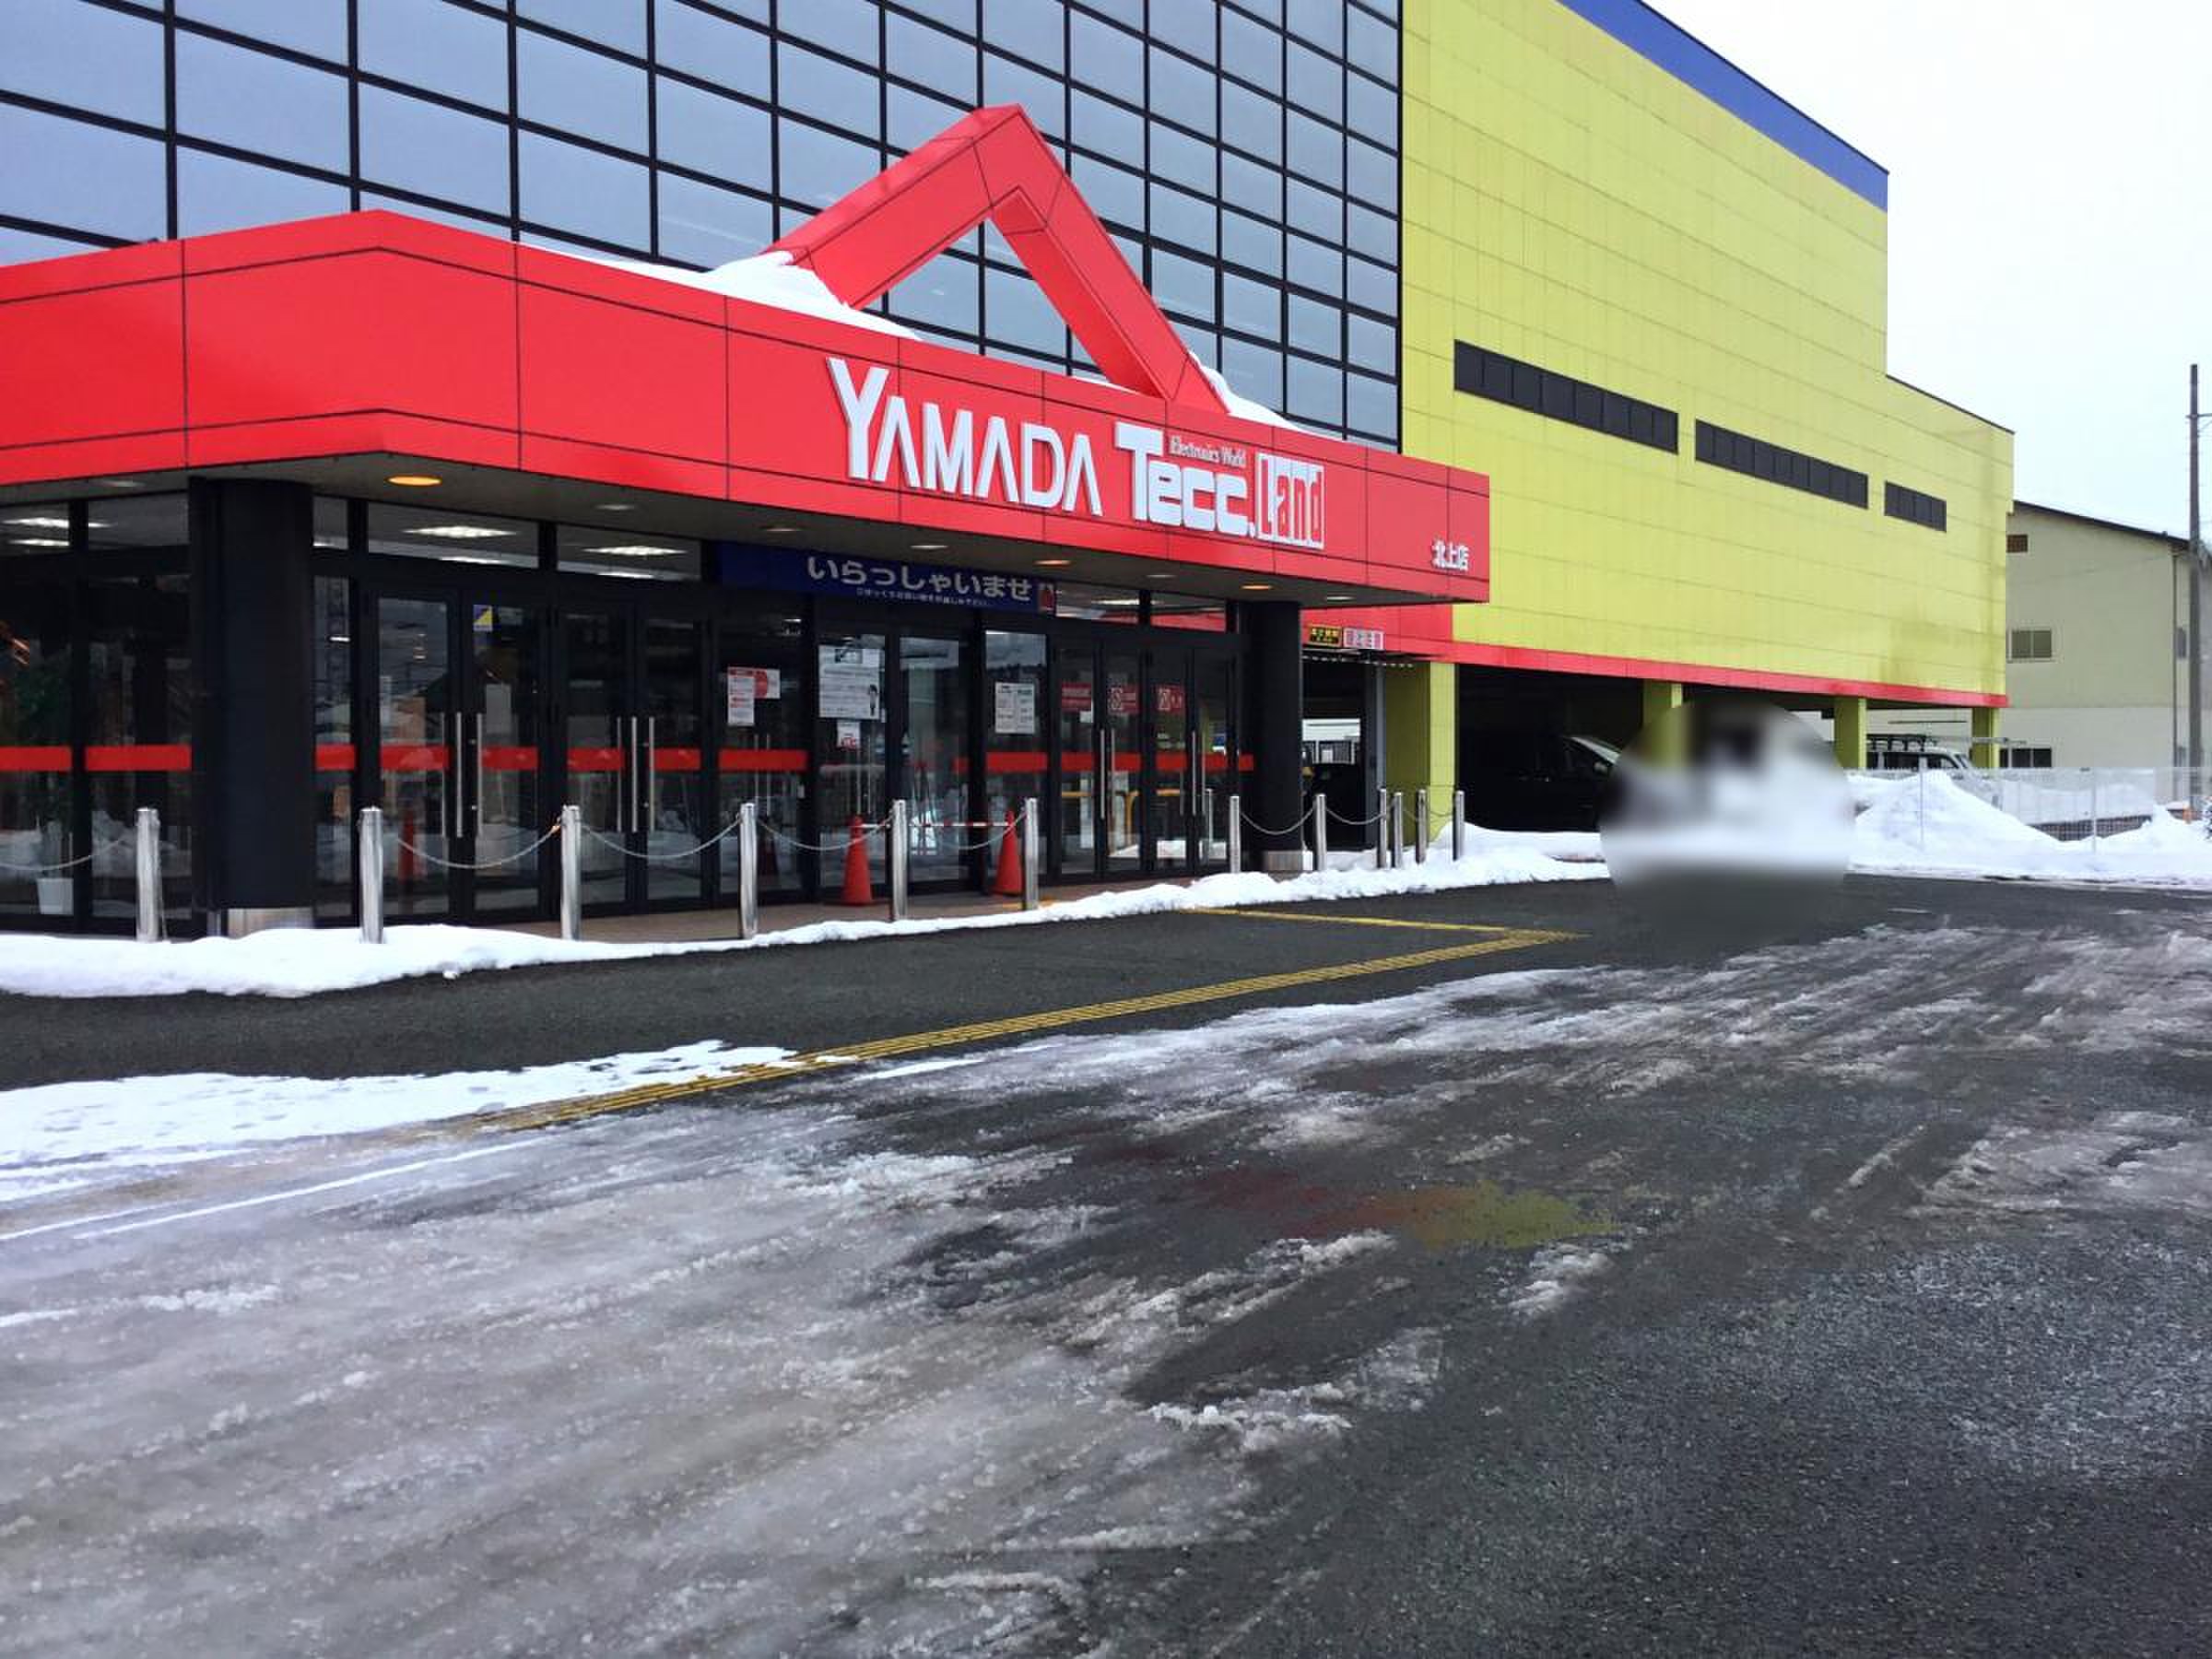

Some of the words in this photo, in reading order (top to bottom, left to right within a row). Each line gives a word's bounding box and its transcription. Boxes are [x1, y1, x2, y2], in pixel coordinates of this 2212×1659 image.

[827, 356, 1103, 517] YAMADA
[1430, 538, 1469, 571] 北上店
[806, 556, 1032, 601] いらっしゃいませ
